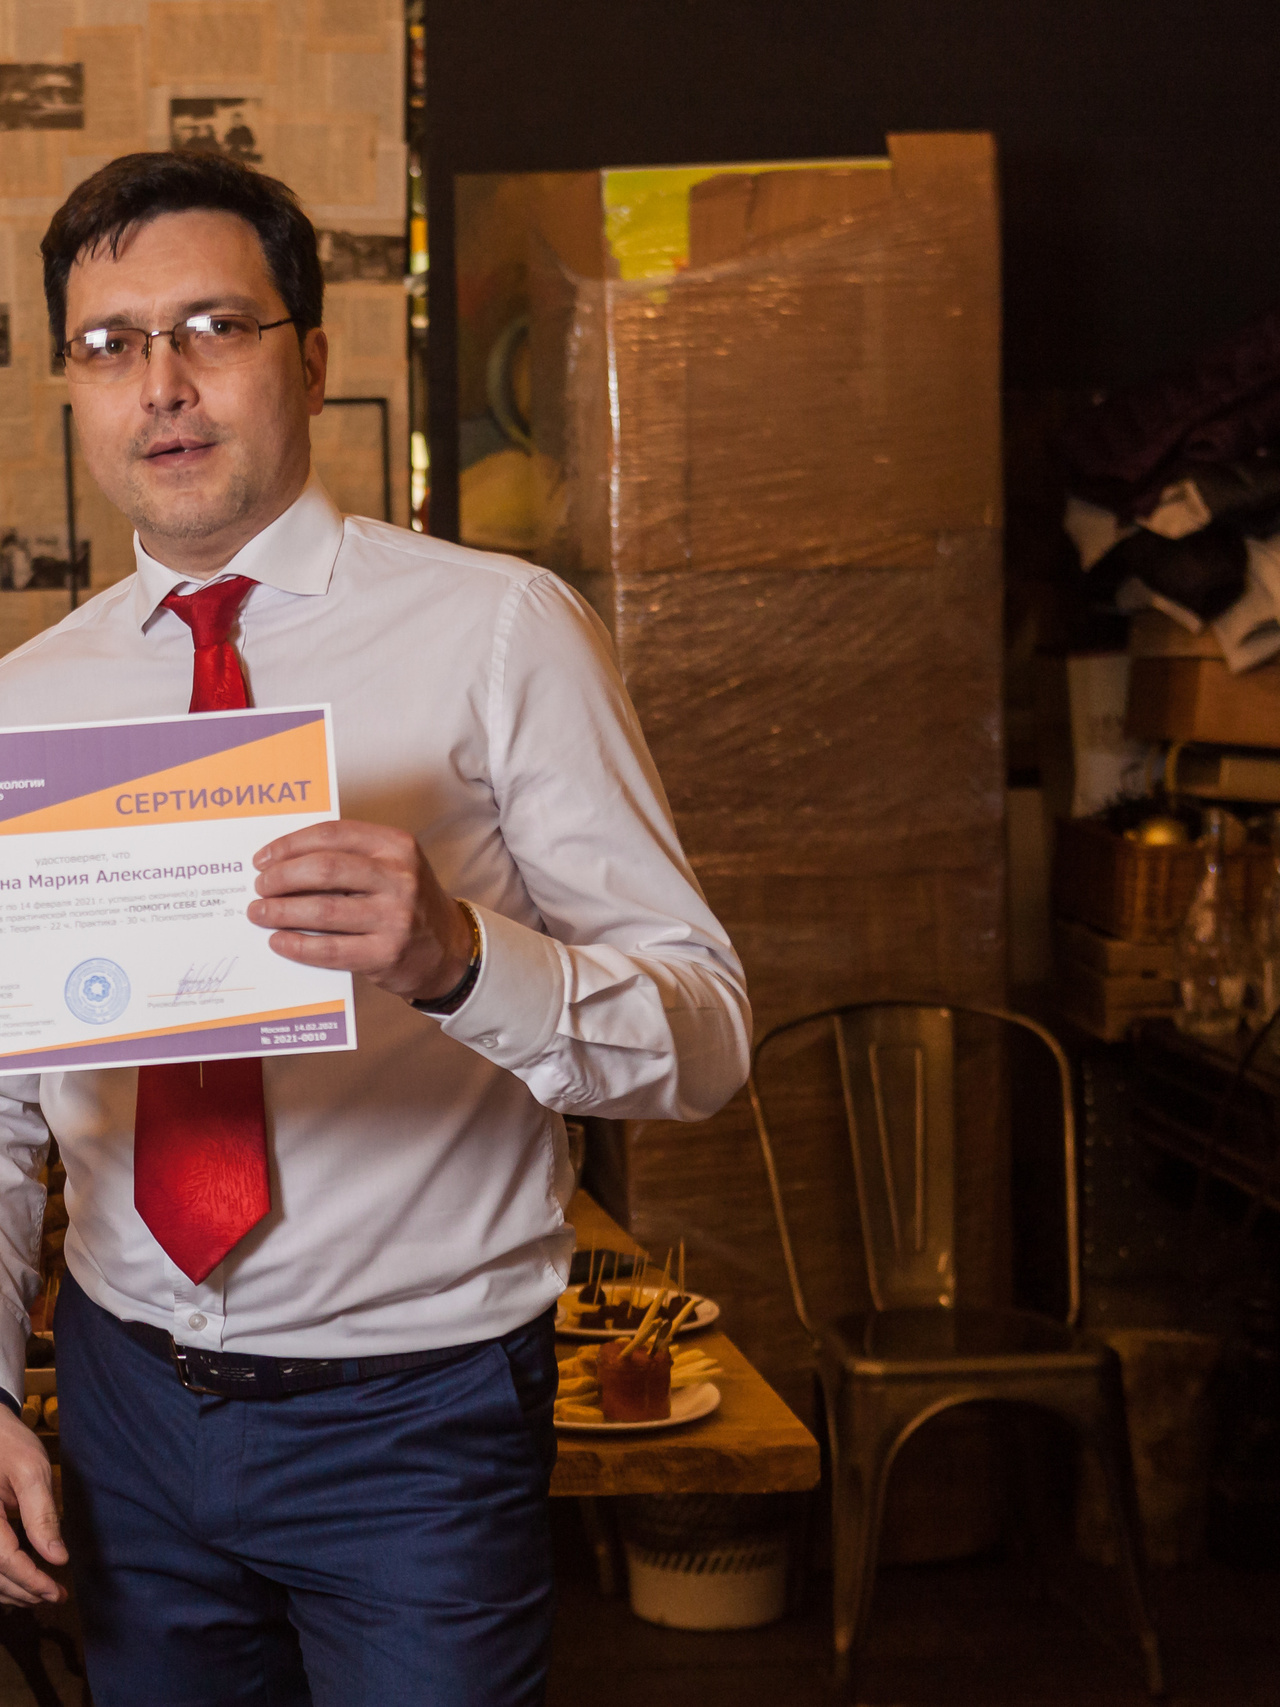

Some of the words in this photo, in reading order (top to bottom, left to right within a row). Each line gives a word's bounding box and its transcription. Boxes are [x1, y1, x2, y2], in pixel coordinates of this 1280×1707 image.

[115, 780, 311, 815] СЕРТИФИКАТ
[34, 853, 108, 867] удостоверяет,
[111, 851, 130, 859] что
[28, 873, 89, 890] Мария
[95, 860, 243, 883] Александровна
[74, 896, 95, 905] 2021
[123, 902, 170, 912] «ПОМОГИ
[172, 900, 196, 909] СЕБЕ
[199, 898, 225, 907] САМ»
[126, 916, 137, 924] 30
[223, 908, 234, 917] 20
[273, 1031, 326, 1044] 2021-0010
